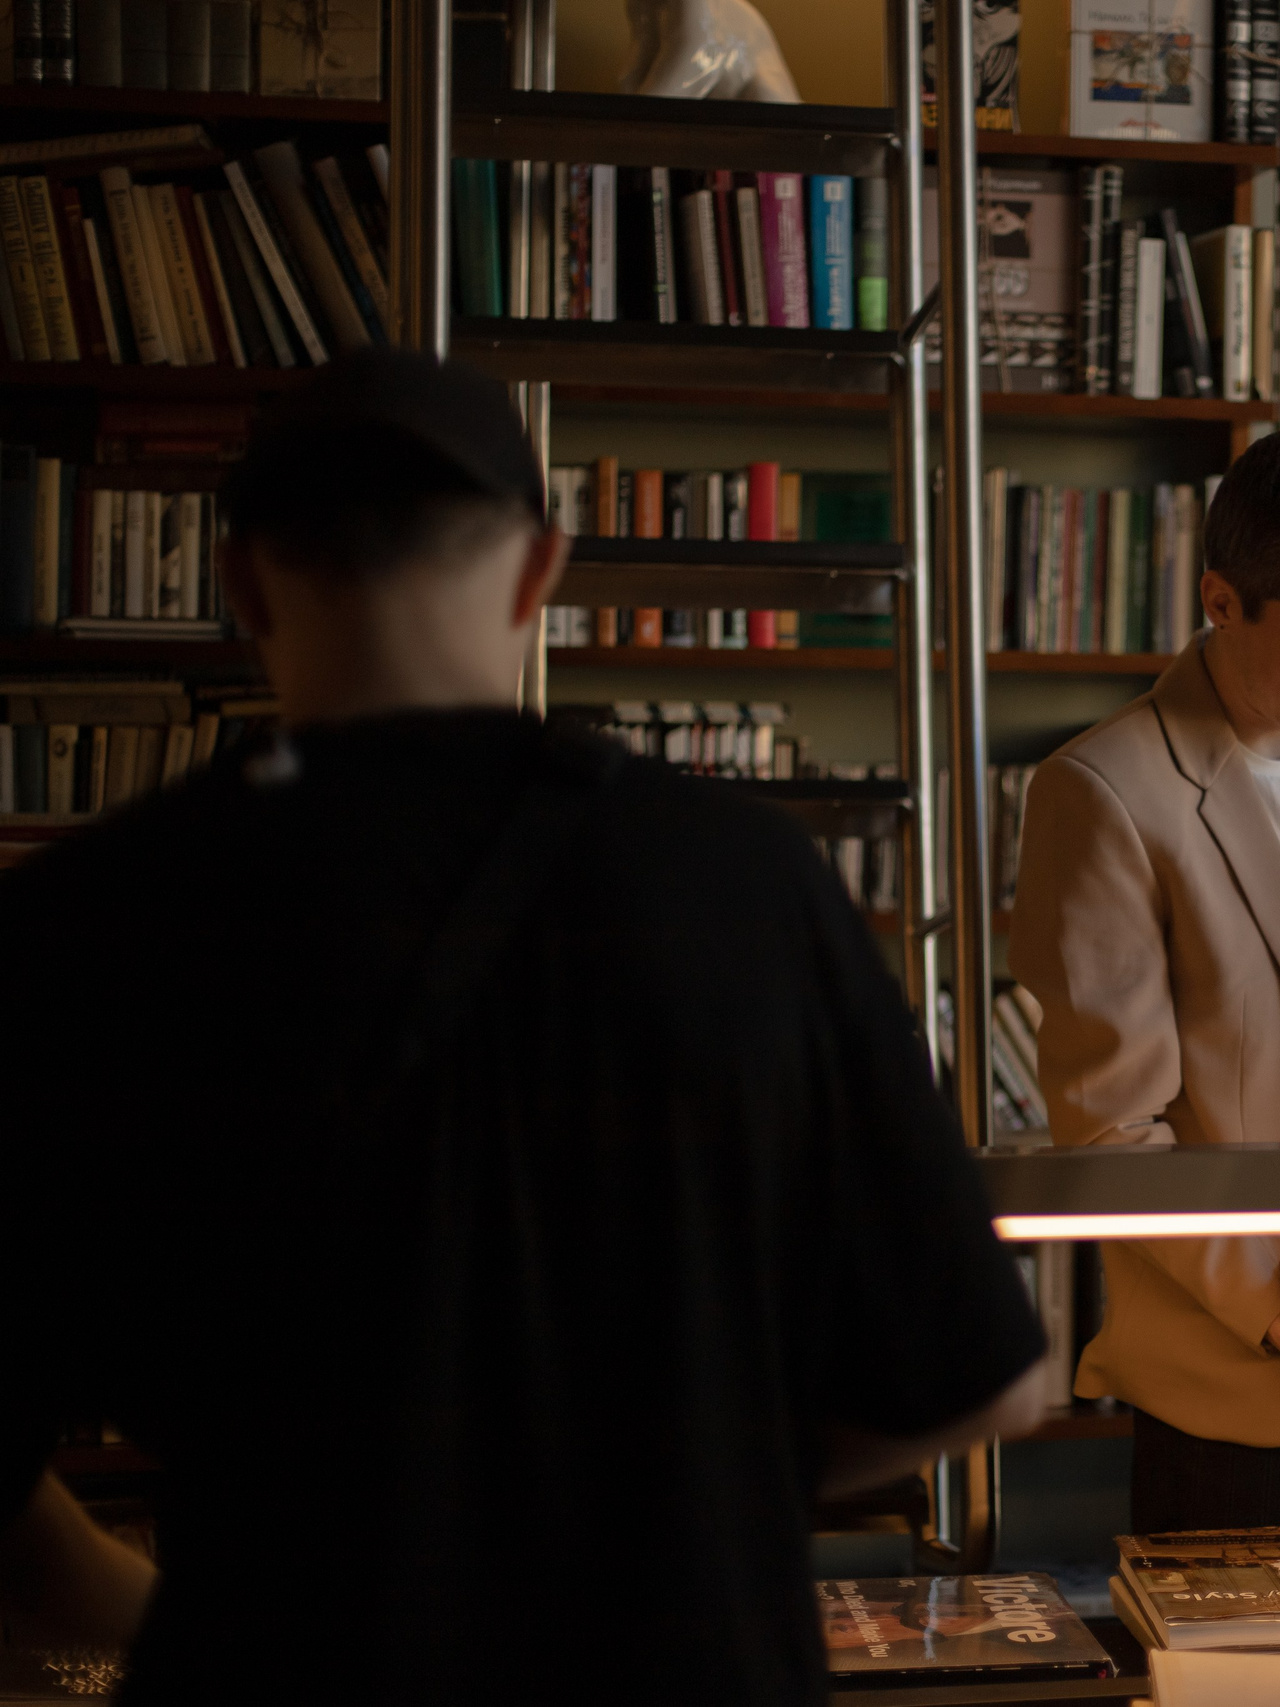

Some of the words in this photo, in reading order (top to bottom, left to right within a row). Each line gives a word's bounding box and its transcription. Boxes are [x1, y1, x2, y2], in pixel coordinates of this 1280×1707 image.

[835, 1580, 859, 1595] Who
[842, 1595, 869, 1609] Died
[1172, 1591, 1257, 1601] Style
[850, 1610, 873, 1623] and
[972, 1575, 1056, 1643] Victore
[857, 1623, 885, 1643] Made
[867, 1643, 891, 1658] You
